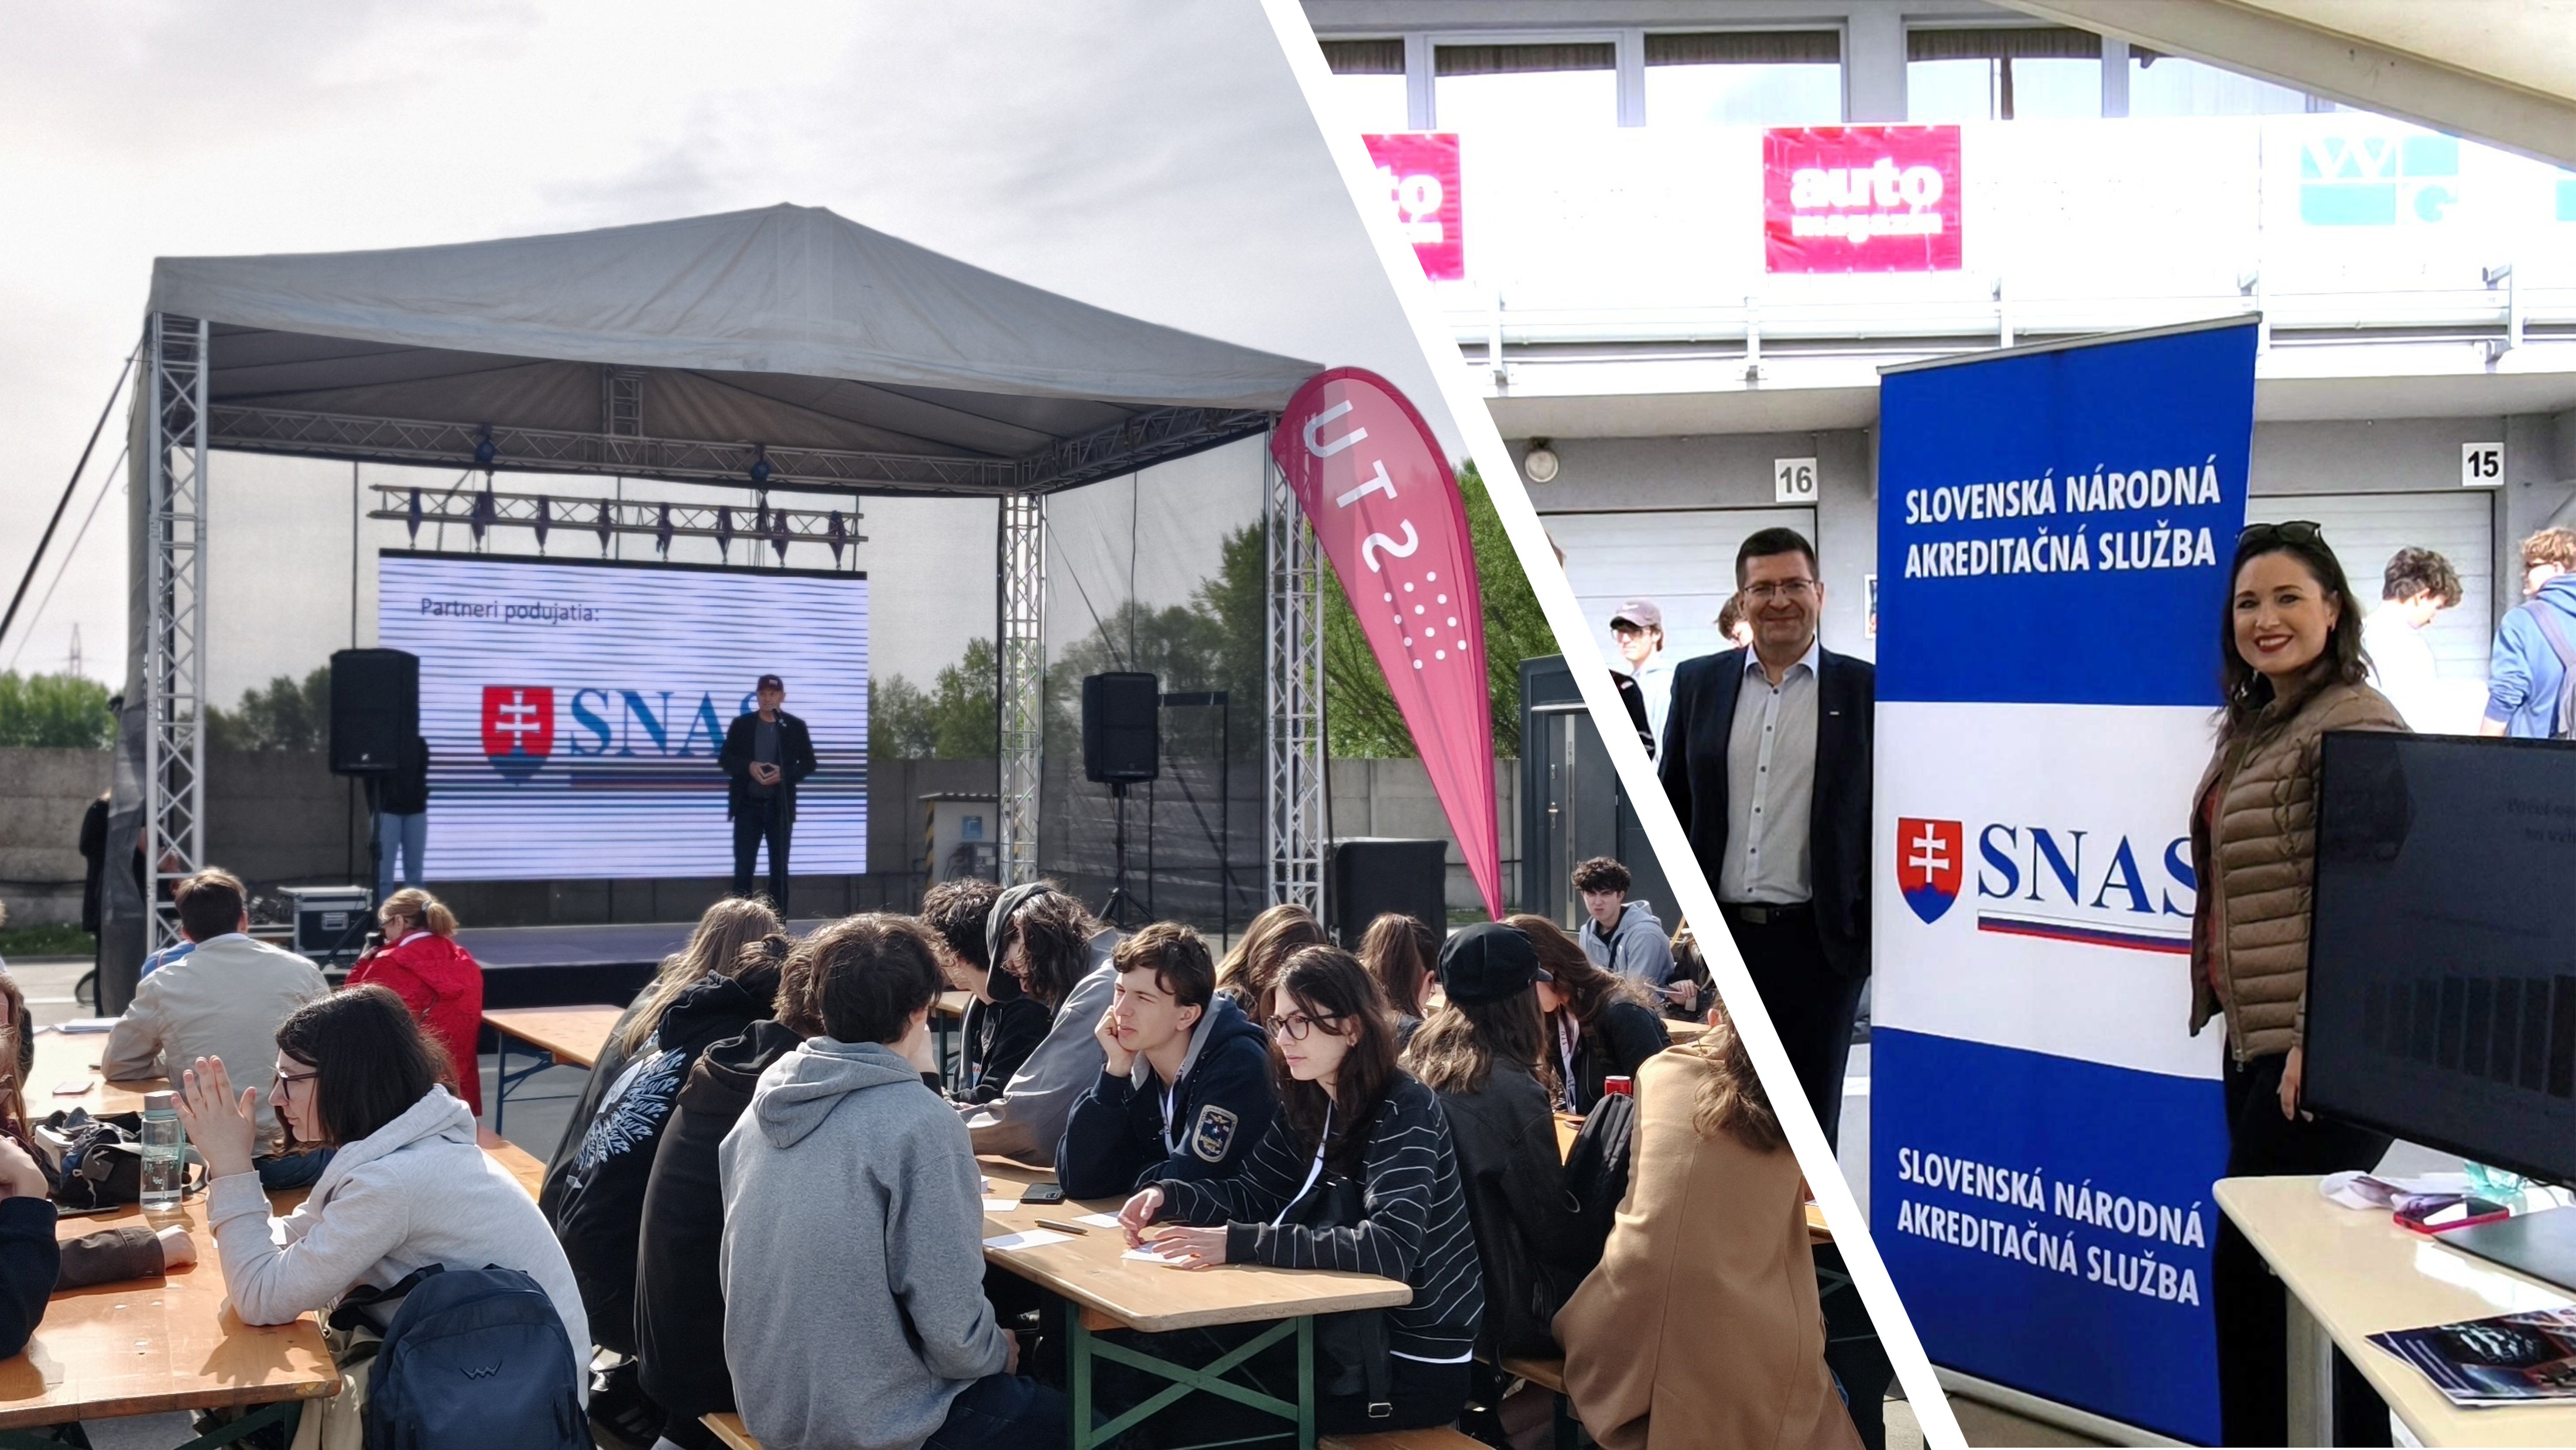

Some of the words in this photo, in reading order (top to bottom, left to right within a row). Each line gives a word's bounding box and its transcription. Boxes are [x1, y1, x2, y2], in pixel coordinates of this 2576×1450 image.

[1790, 156, 1944, 208] auto
[1780, 465, 1813, 493] 16
[1905, 467, 2057, 525] SLOVENSKÁ
[2065, 454, 2221, 513] NÁRODNÁ
[2467, 451, 2499, 478] 15
[1904, 523, 2090, 578] AKREDITAČNÁ
[2098, 519, 2217, 571] SLUŽBA
[421, 597, 498, 618] Partneri
[505, 601, 600, 625] podujatia:
[571, 687, 757, 757] SNA
[1978, 823, 2198, 918] SNAS
[1897, 1147, 2046, 1212] SLOVENSKÁ
[2054, 1178, 2205, 1249] NÁRODNÁ
[1897, 1199, 2078, 1276] AKREDITAČNÁ
[2086, 1246, 2201, 1307] SLUŽBA
